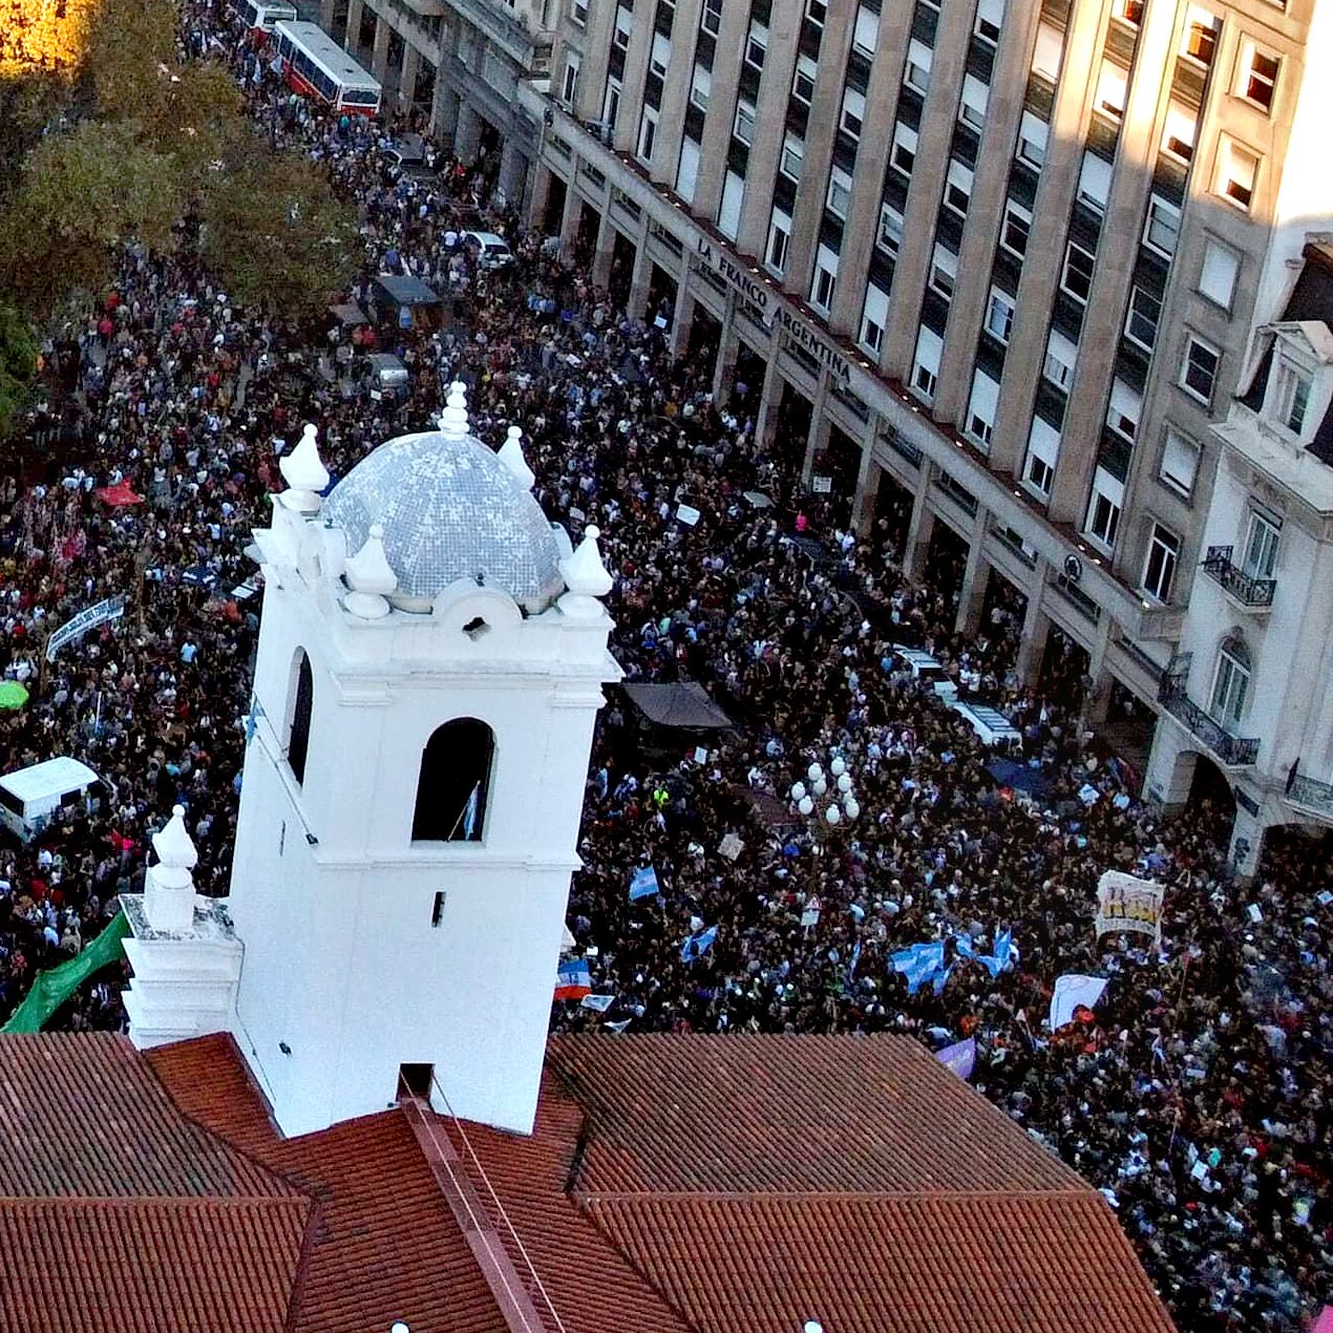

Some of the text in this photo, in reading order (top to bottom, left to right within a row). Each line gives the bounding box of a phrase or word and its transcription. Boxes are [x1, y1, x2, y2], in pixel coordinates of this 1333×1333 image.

[698, 238, 712, 261] LA
[719, 256, 768, 307] FRANCO
[772, 306, 852, 384] ARGENTINA
